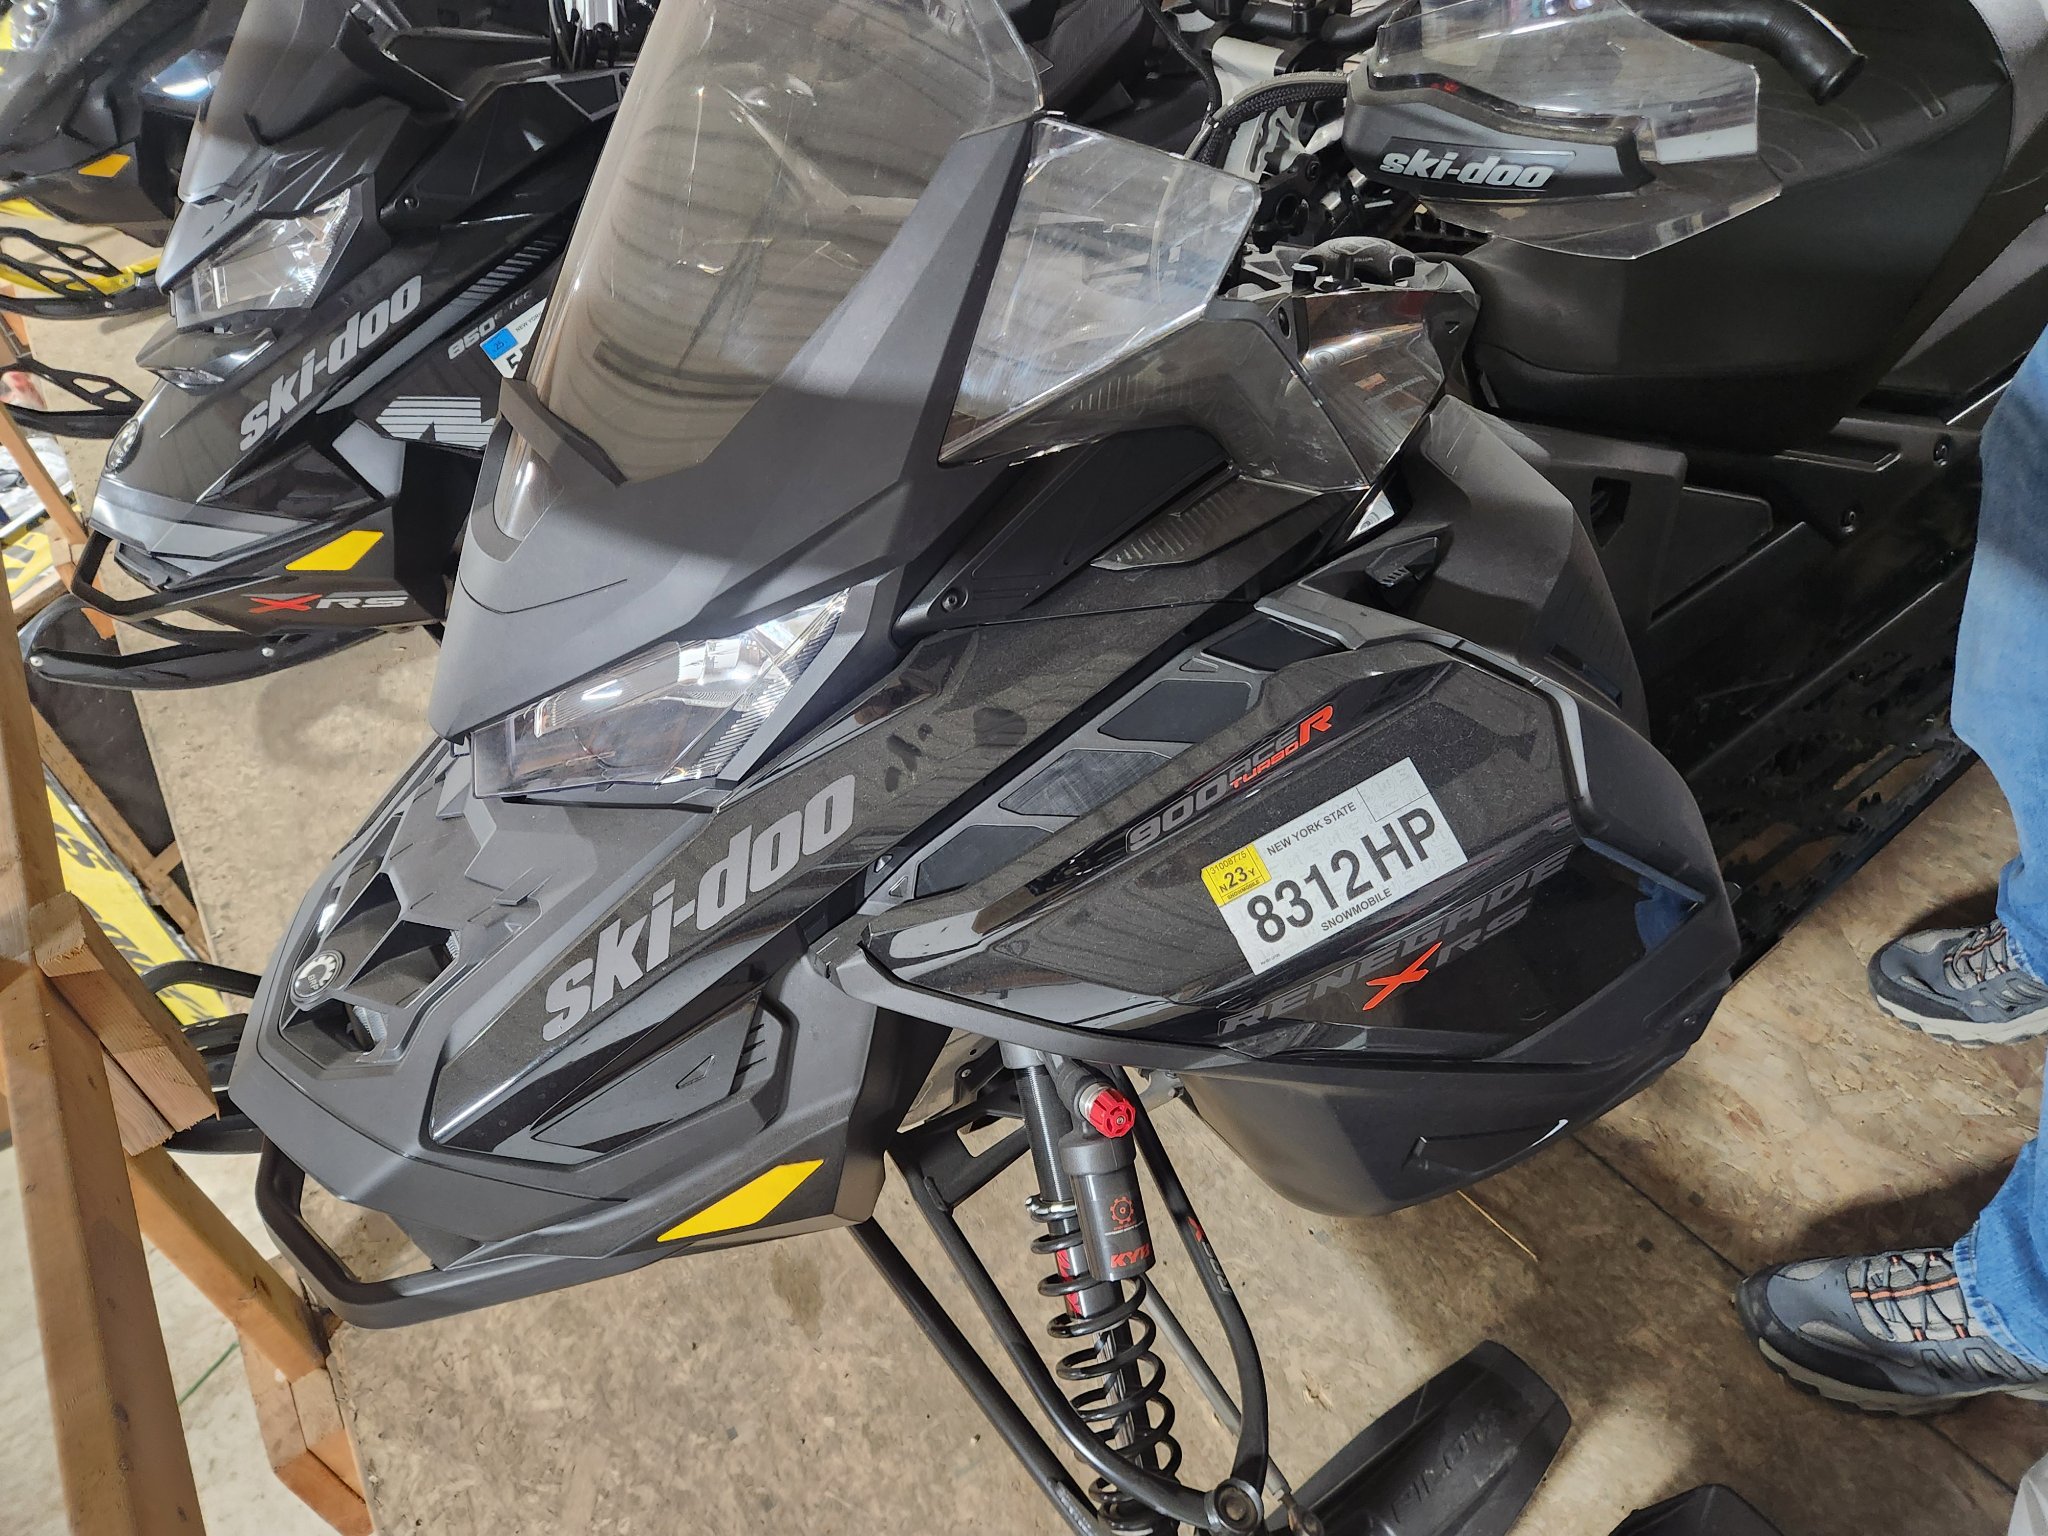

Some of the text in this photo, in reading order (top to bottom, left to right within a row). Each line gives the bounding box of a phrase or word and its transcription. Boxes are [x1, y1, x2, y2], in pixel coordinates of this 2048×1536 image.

[1379, 148, 1556, 188] ski-doo
[447, 317, 496, 360] 850
[515, 322, 528, 333] NEW
[239, 275, 422, 452] ski-doo
[1229, 705, 1334, 789] TURBO R
[1129, 774, 1228, 852] 900
[1267, 801, 1357, 856] NEW YORK STATE
[1226, 879, 1261, 900] SNOWMOBILE
[1247, 807, 1436, 944] 8312HP
[542, 774, 856, 1042] ski-doo
[1320, 887, 1393, 932] SNOWMOBILE
[1222, 845, 1573, 1036] RENEGADE
[307, 974, 319, 990] BRP
